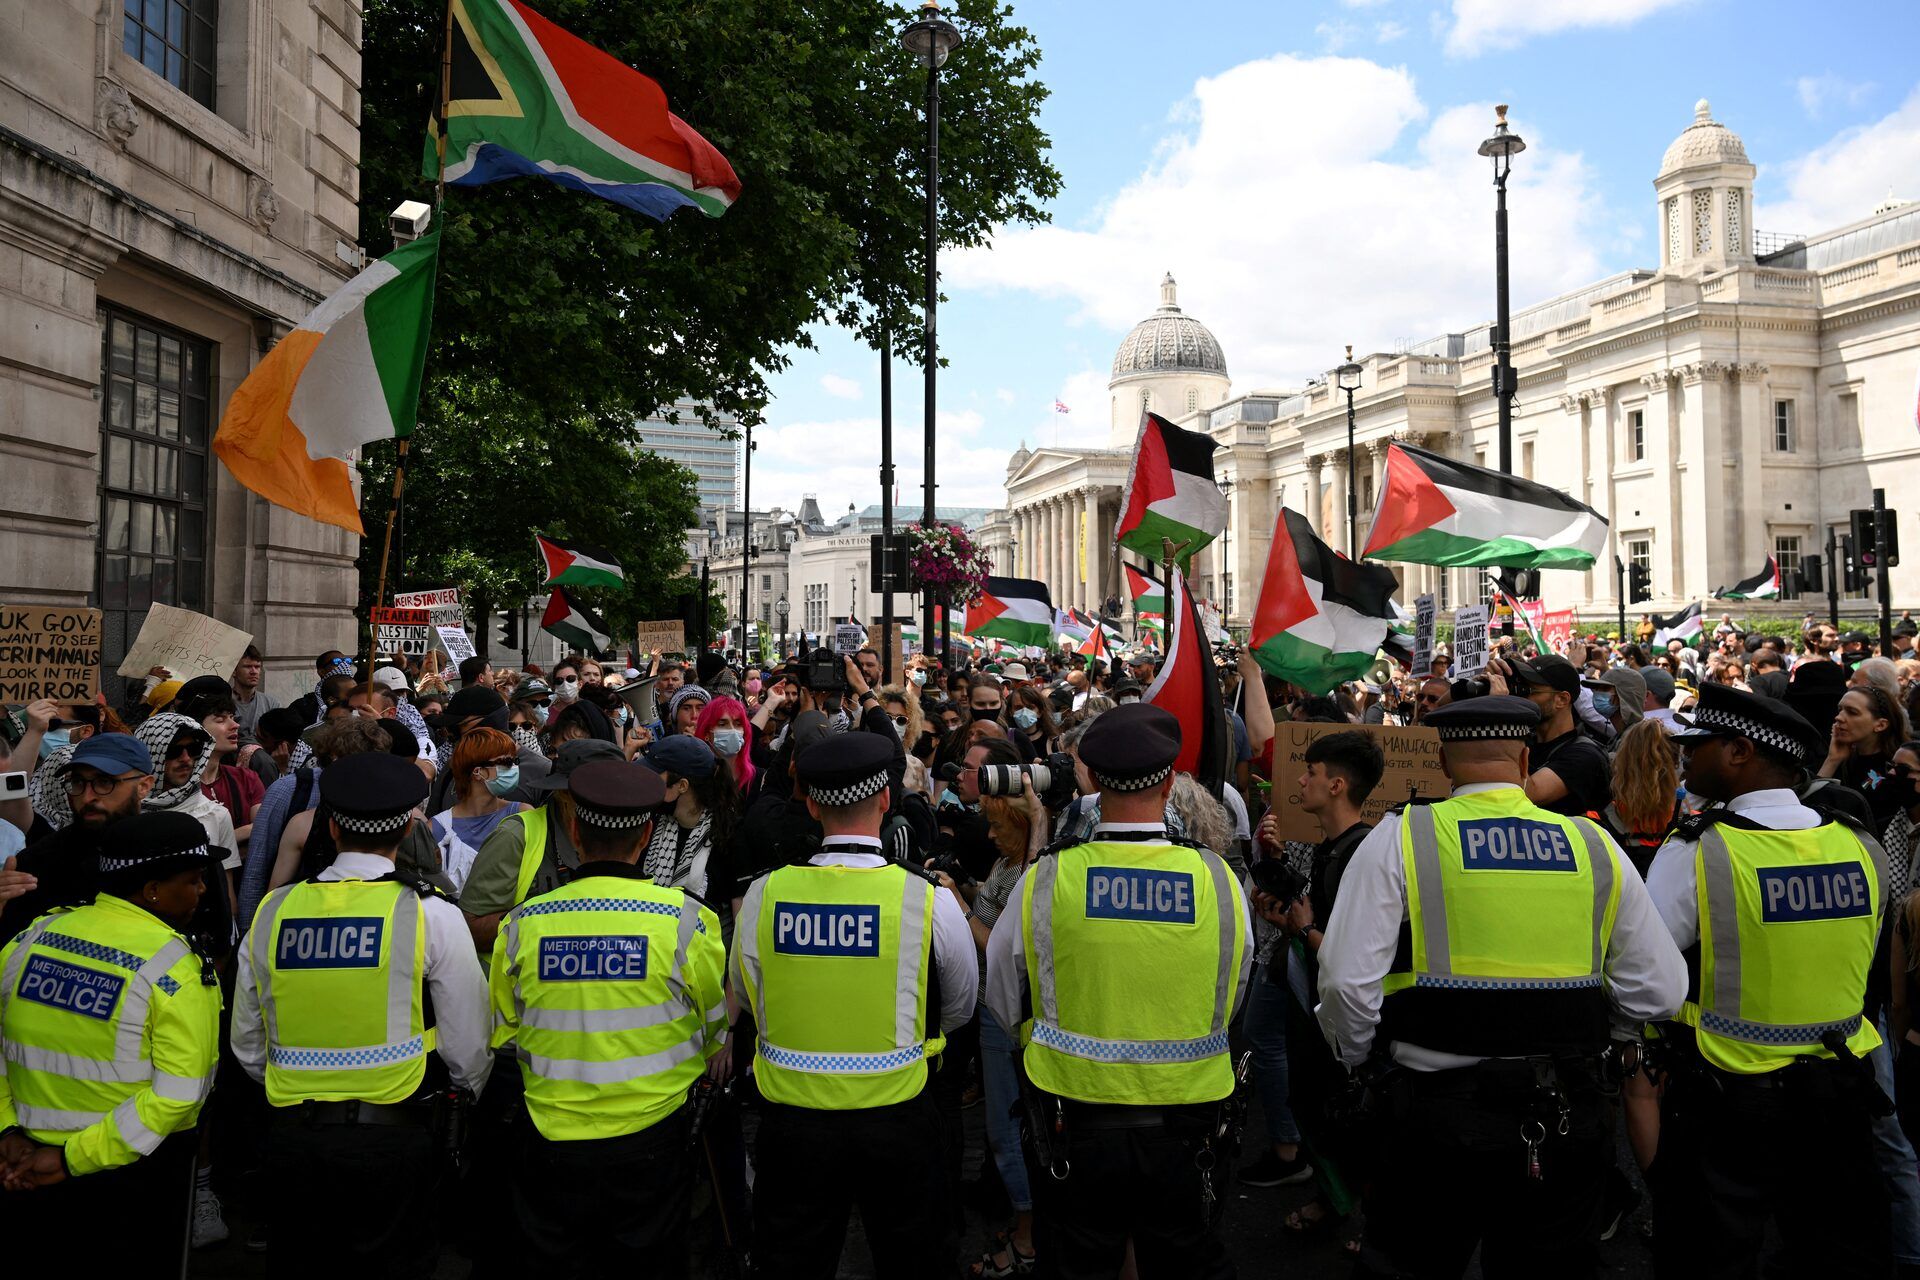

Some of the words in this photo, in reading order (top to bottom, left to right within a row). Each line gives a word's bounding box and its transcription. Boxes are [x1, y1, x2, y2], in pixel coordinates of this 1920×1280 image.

[395, 596, 414, 607] KEIR
[413, 588, 458, 607] STARVER
[0, 612, 29, 631] UK
[391, 610, 410, 622] ARE
[372, 625, 427, 639] ALESTINE
[648, 622, 677, 632] STAND
[1456, 626, 1473, 642] HANDS
[1474, 624, 1485, 638] OFF
[0, 633, 42, 645] WANT
[49, 634, 67, 645] TO
[71, 635, 97, 646] SEE
[1456, 638, 1486, 657] PALESTINE
[0, 646, 99, 666] CRIMINALS
[194, 654, 222, 676] FOR
[1461, 653, 1481, 670] ACTION
[0, 668, 37, 679] LOOK
[44, 668, 60, 678] IN
[64, 669, 92, 680] THE
[0, 682, 90, 700] MIRROR
[1291, 728, 1321, 746] UK
[1423, 760, 1442, 770] KIDS
[1466, 826, 1570, 861] POLICE
[1092, 876, 1189, 912] POLICE
[1765, 871, 1865, 912] POLICE
[778, 911, 873, 947] POLICE
[281, 926, 376, 960] POLICE
[544, 940, 642, 951] METROPOLITAN
[543, 953, 641, 976] POLICE
[31, 959, 120, 991] METROPOLITAN
[21, 973, 113, 1015] POLICE
